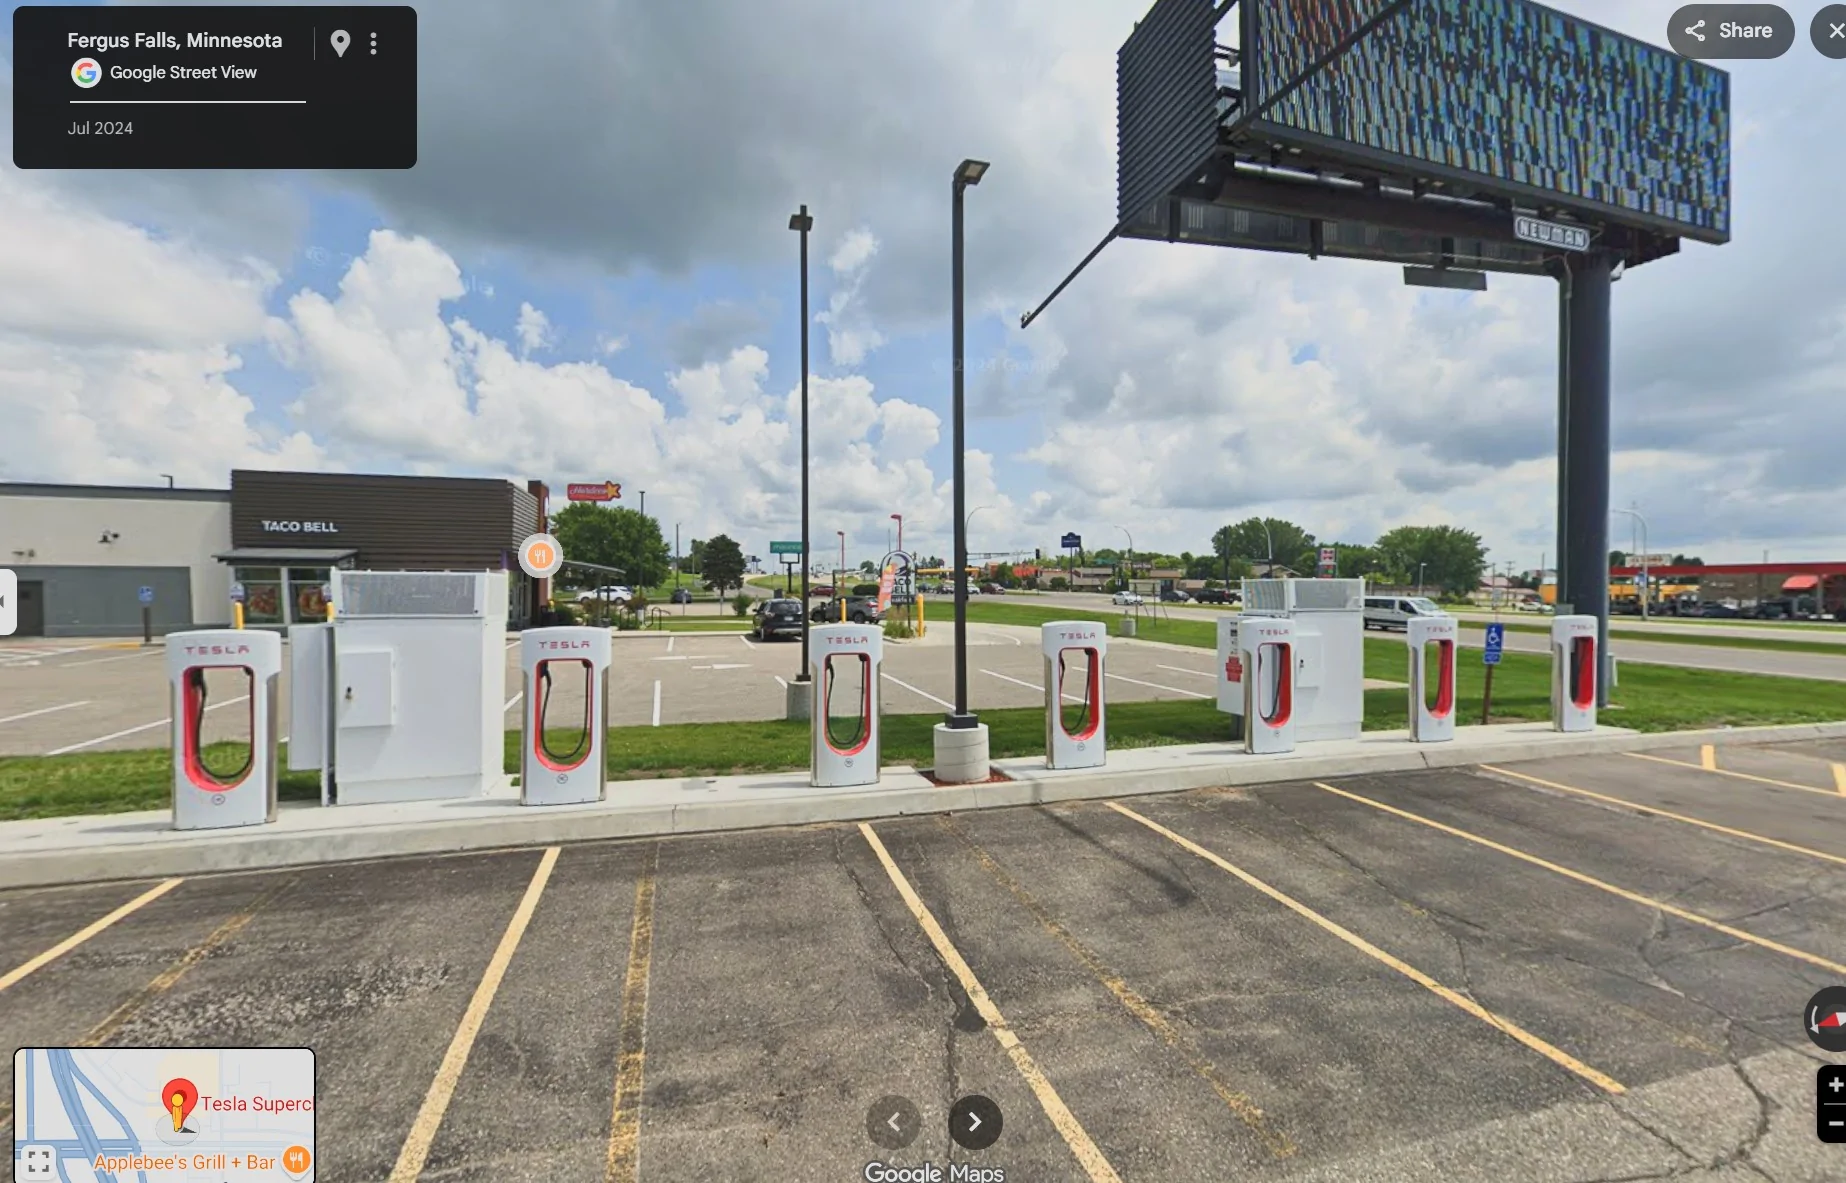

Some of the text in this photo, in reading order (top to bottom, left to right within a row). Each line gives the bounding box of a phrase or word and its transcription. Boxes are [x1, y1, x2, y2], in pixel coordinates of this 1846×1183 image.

[1519, 219, 1585, 247] NEWMAN
[261, 519, 338, 533] TACO BELL
[538, 640, 591, 650] TESLA
[825, 636, 869, 644] TESLA
[185, 645, 250, 656] TESLA
